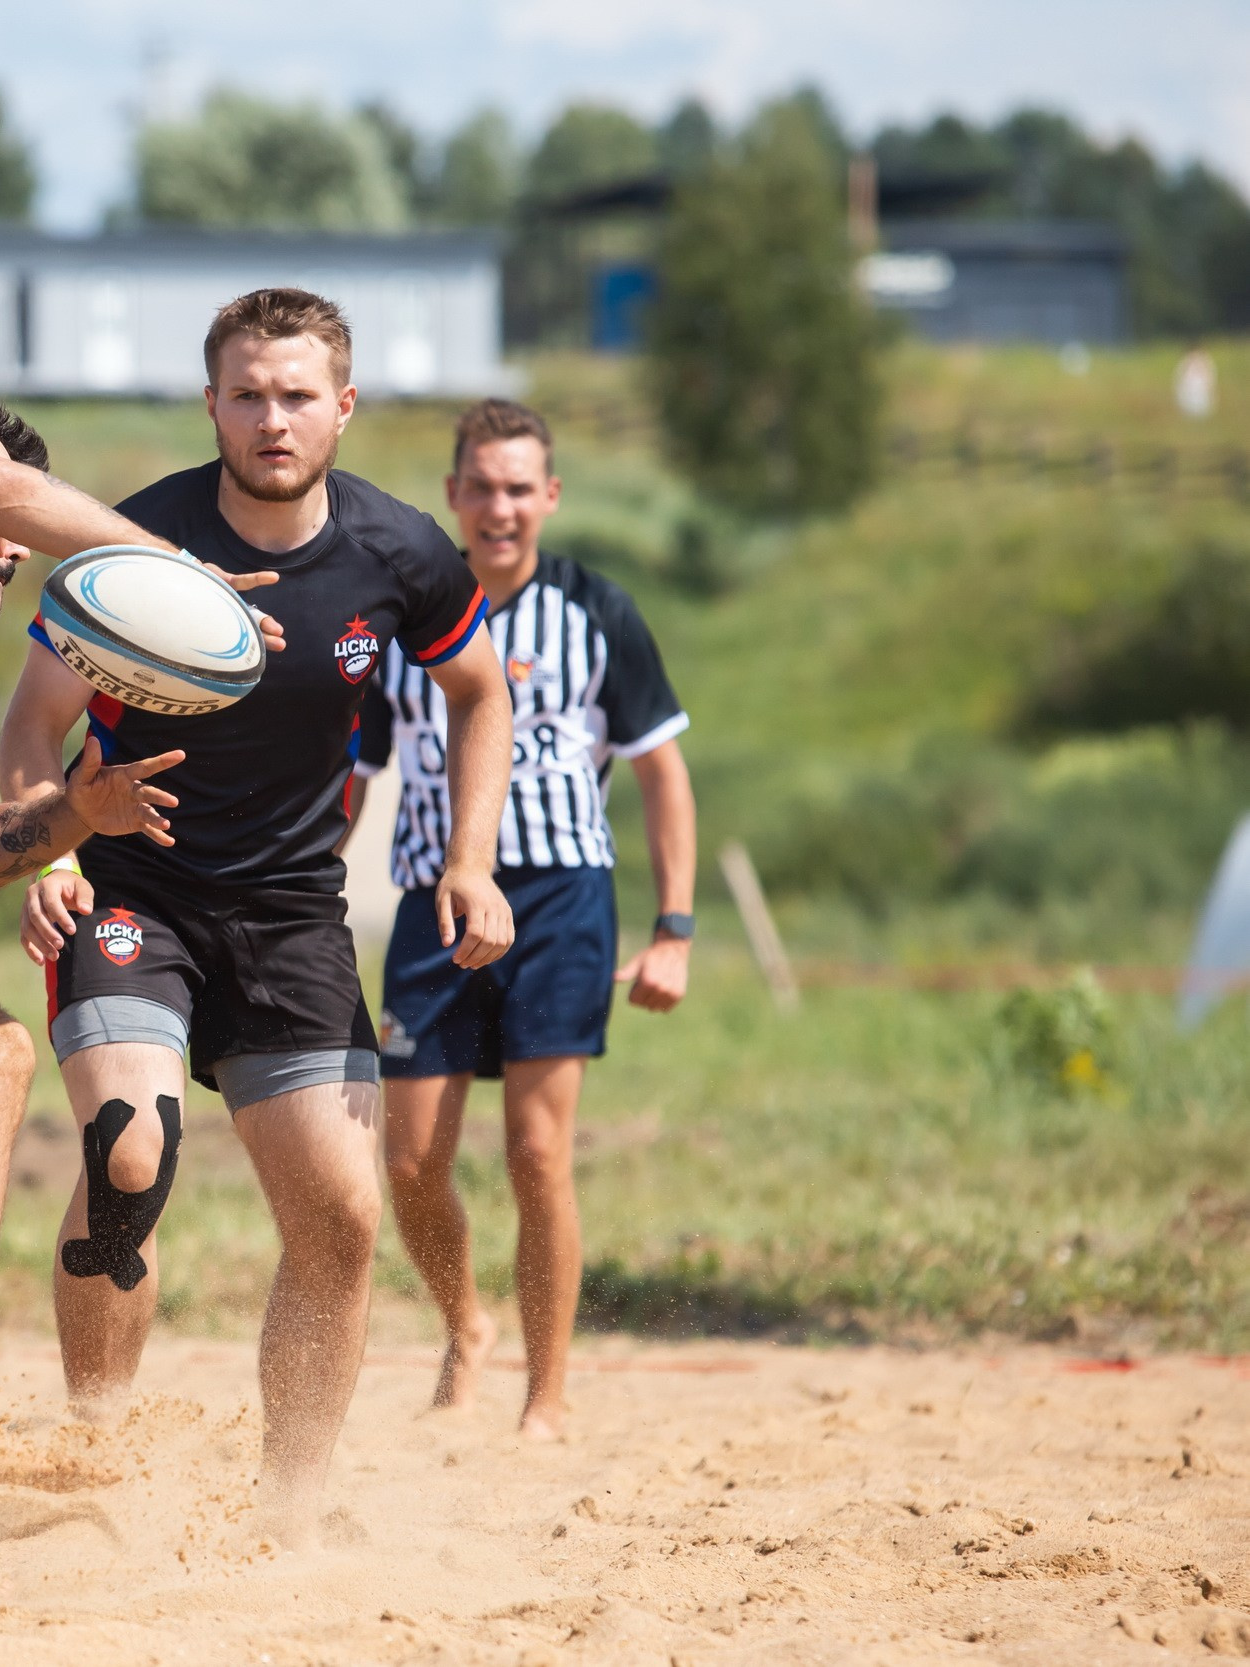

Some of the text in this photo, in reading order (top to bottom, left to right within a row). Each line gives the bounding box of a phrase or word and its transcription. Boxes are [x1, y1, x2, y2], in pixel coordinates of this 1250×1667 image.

[334, 638, 379, 657] ЦСКА
[55, 640, 220, 714] GILBERT
[95, 923, 143, 945] ЦСКА
